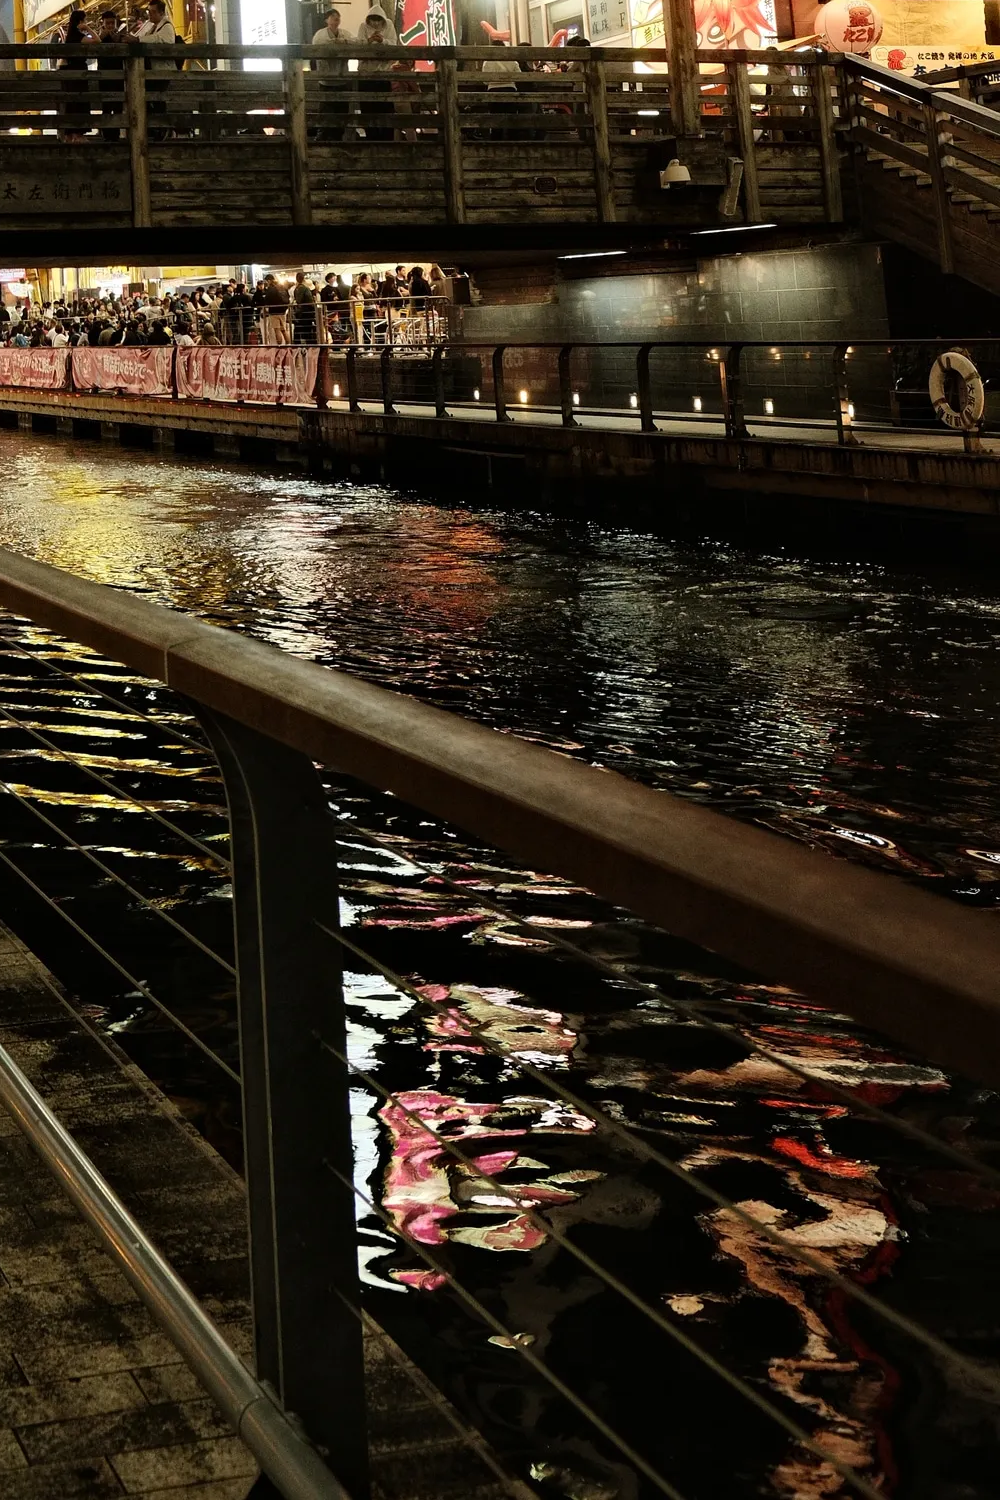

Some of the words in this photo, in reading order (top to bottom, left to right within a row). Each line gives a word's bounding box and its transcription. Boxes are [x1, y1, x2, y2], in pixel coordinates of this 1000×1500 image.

[918, 51, 945, 60] たこ焼き
[948, 51, 978, 60] 発祥の地
[980, 51, 995, 60] 大阪
[2, 181, 120, 200] 太左衛門橋
